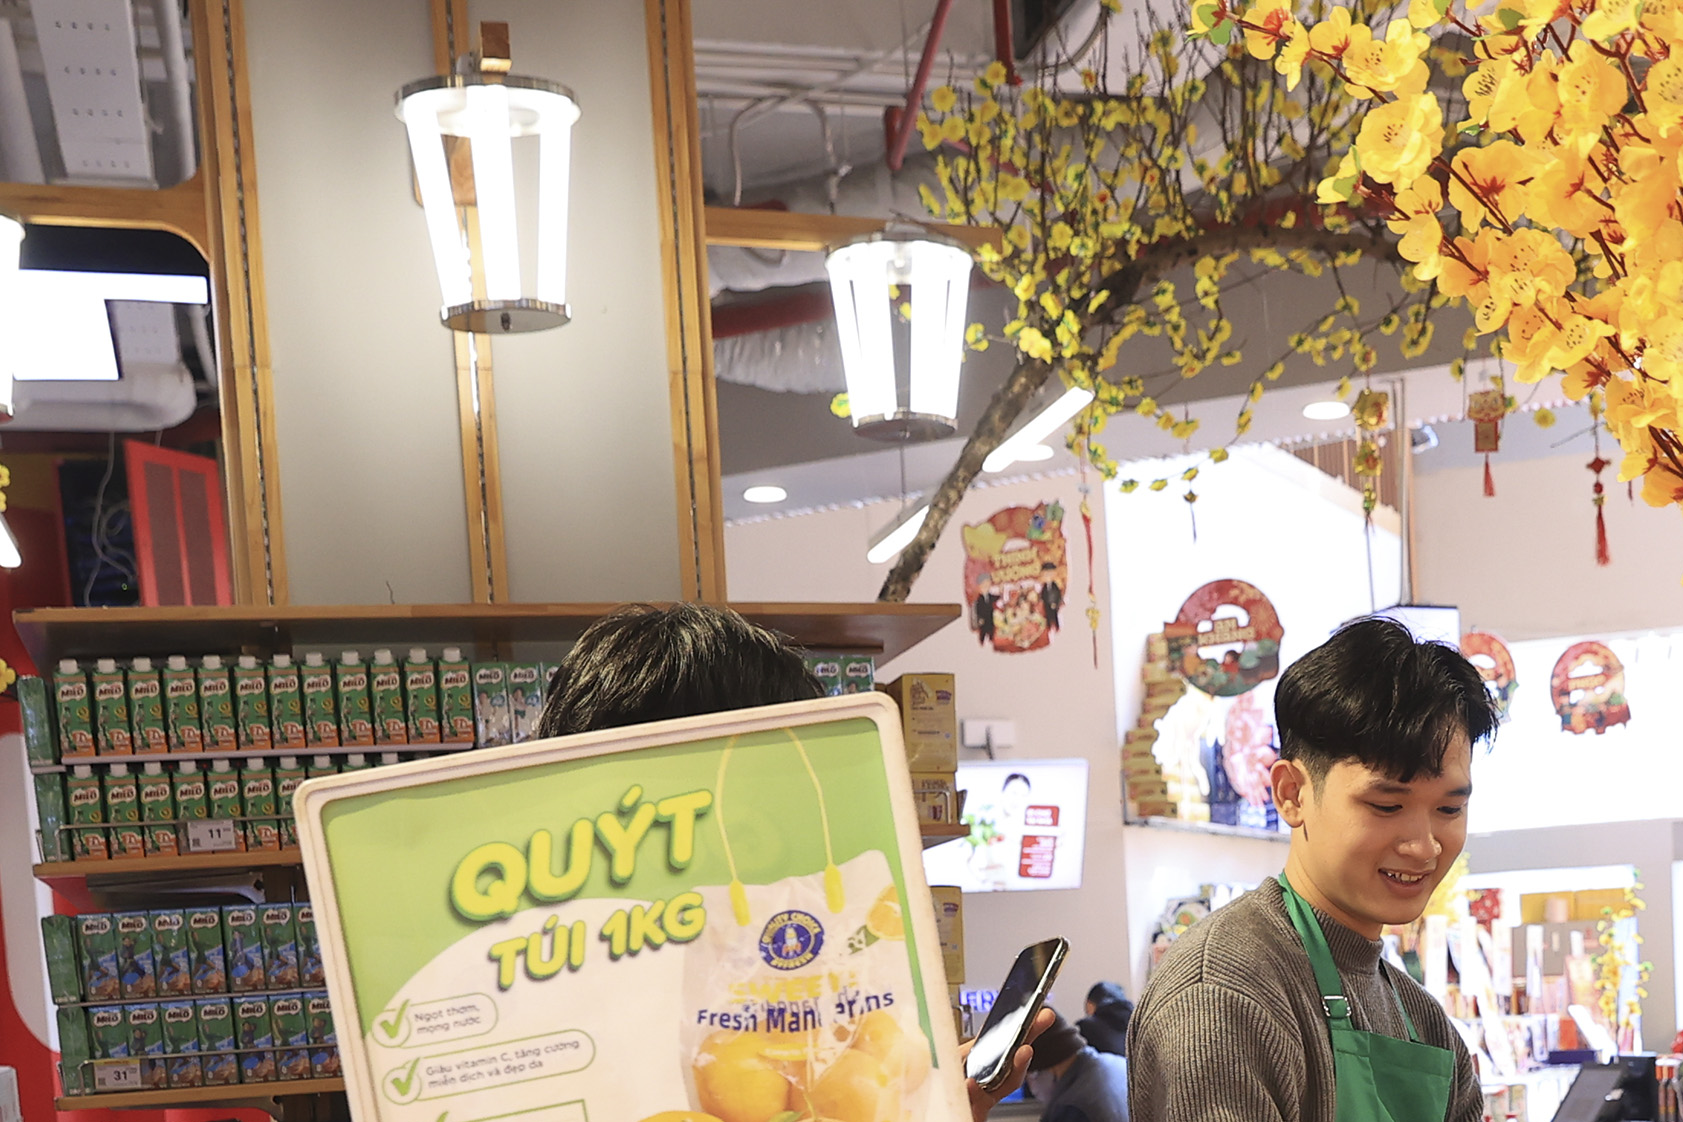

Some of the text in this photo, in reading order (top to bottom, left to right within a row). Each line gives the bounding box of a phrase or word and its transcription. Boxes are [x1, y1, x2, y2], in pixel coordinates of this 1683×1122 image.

[410, 675, 432, 687] MILO
[444, 674, 467, 686] MILO
[478, 669, 501, 682] MILO
[513, 669, 535, 681] MILO
[203, 681, 226, 694] MILO
[239, 681, 262, 693] MILO
[274, 679, 297, 692] MILO
[306, 678, 330, 690] MILO
[343, 677, 365, 689] MILO
[376, 676, 399, 688] MILO
[60, 685, 84, 698] MILO
[98, 684, 122, 697] MILO
[134, 683, 157, 696] MILO
[170, 682, 193, 695] MILO
[144, 787, 167, 799] MILO
[179, 786, 202, 798] MILO
[213, 784, 236, 796] MILO
[247, 783, 270, 794] MILO
[74, 791, 97, 803] MILO
[111, 789, 134, 801] MILO
[451, 784, 713, 922] QUÝT
[158, 917, 180, 929] MILO
[193, 916, 216, 927] MILO
[231, 913, 252, 925] MILO
[266, 911, 288, 923] MILO
[85, 921, 108, 933] MILO
[122, 920, 144, 932] MILO
[488, 892, 706, 990] TÚI 1KG
[204, 1006, 225, 1018] MILO
[242, 1003, 264, 1016] MILO
[277, 1001, 299, 1013] MILO
[97, 1013, 119, 1025] MILO
[132, 1010, 155, 1022] MILO
[168, 1009, 190, 1020] MILO
[697, 1009, 757, 1033] Fresh
[455, 1055, 497, 1071] vitamin
